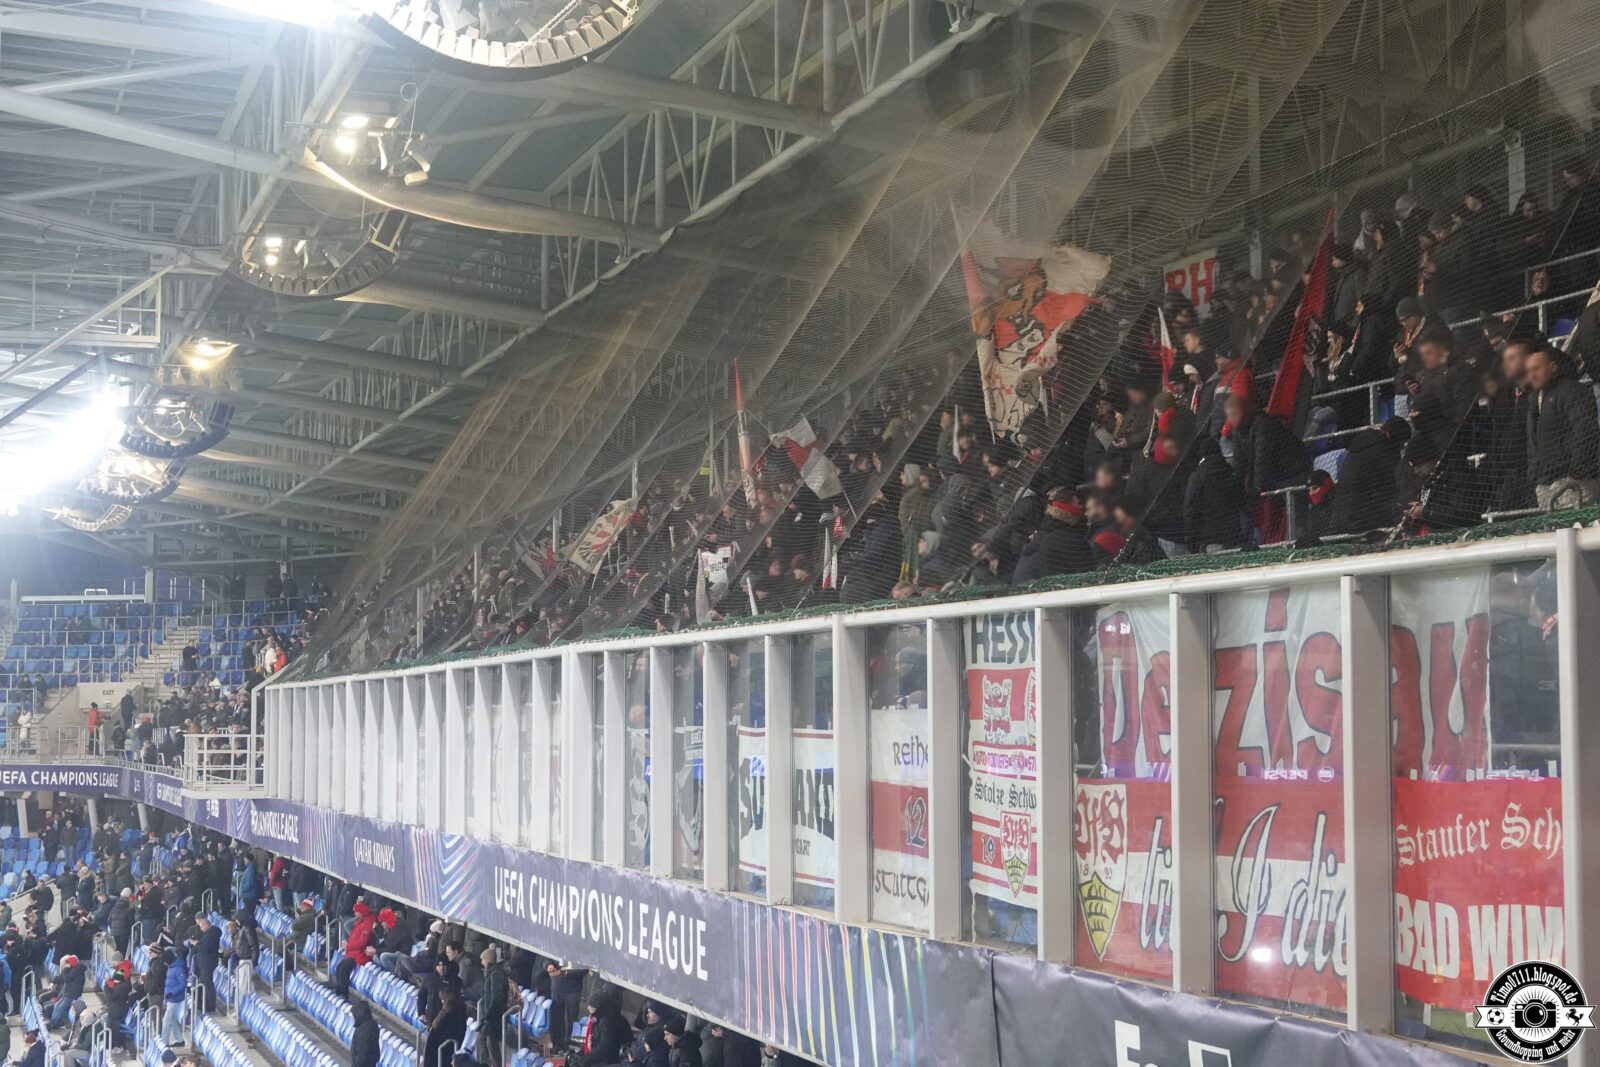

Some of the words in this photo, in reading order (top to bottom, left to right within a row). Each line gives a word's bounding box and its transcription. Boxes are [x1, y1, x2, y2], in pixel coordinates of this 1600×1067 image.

[31, 771, 98, 787] CHAMPIONS
[99, 773, 119, 788] LEAGUE
[974, 776, 1005, 809] Stolze
[904, 796, 927, 849] 12
[1396, 813, 1491, 868] Staufer
[1500, 802, 1565, 860] Sch
[353, 837, 372, 867] QATAR
[494, 866, 525, 919] UEFA
[529, 875, 624, 951] CHAMPIONS
[627, 900, 709, 982] LEAGUE
[1396, 892, 1461, 980] BAD
